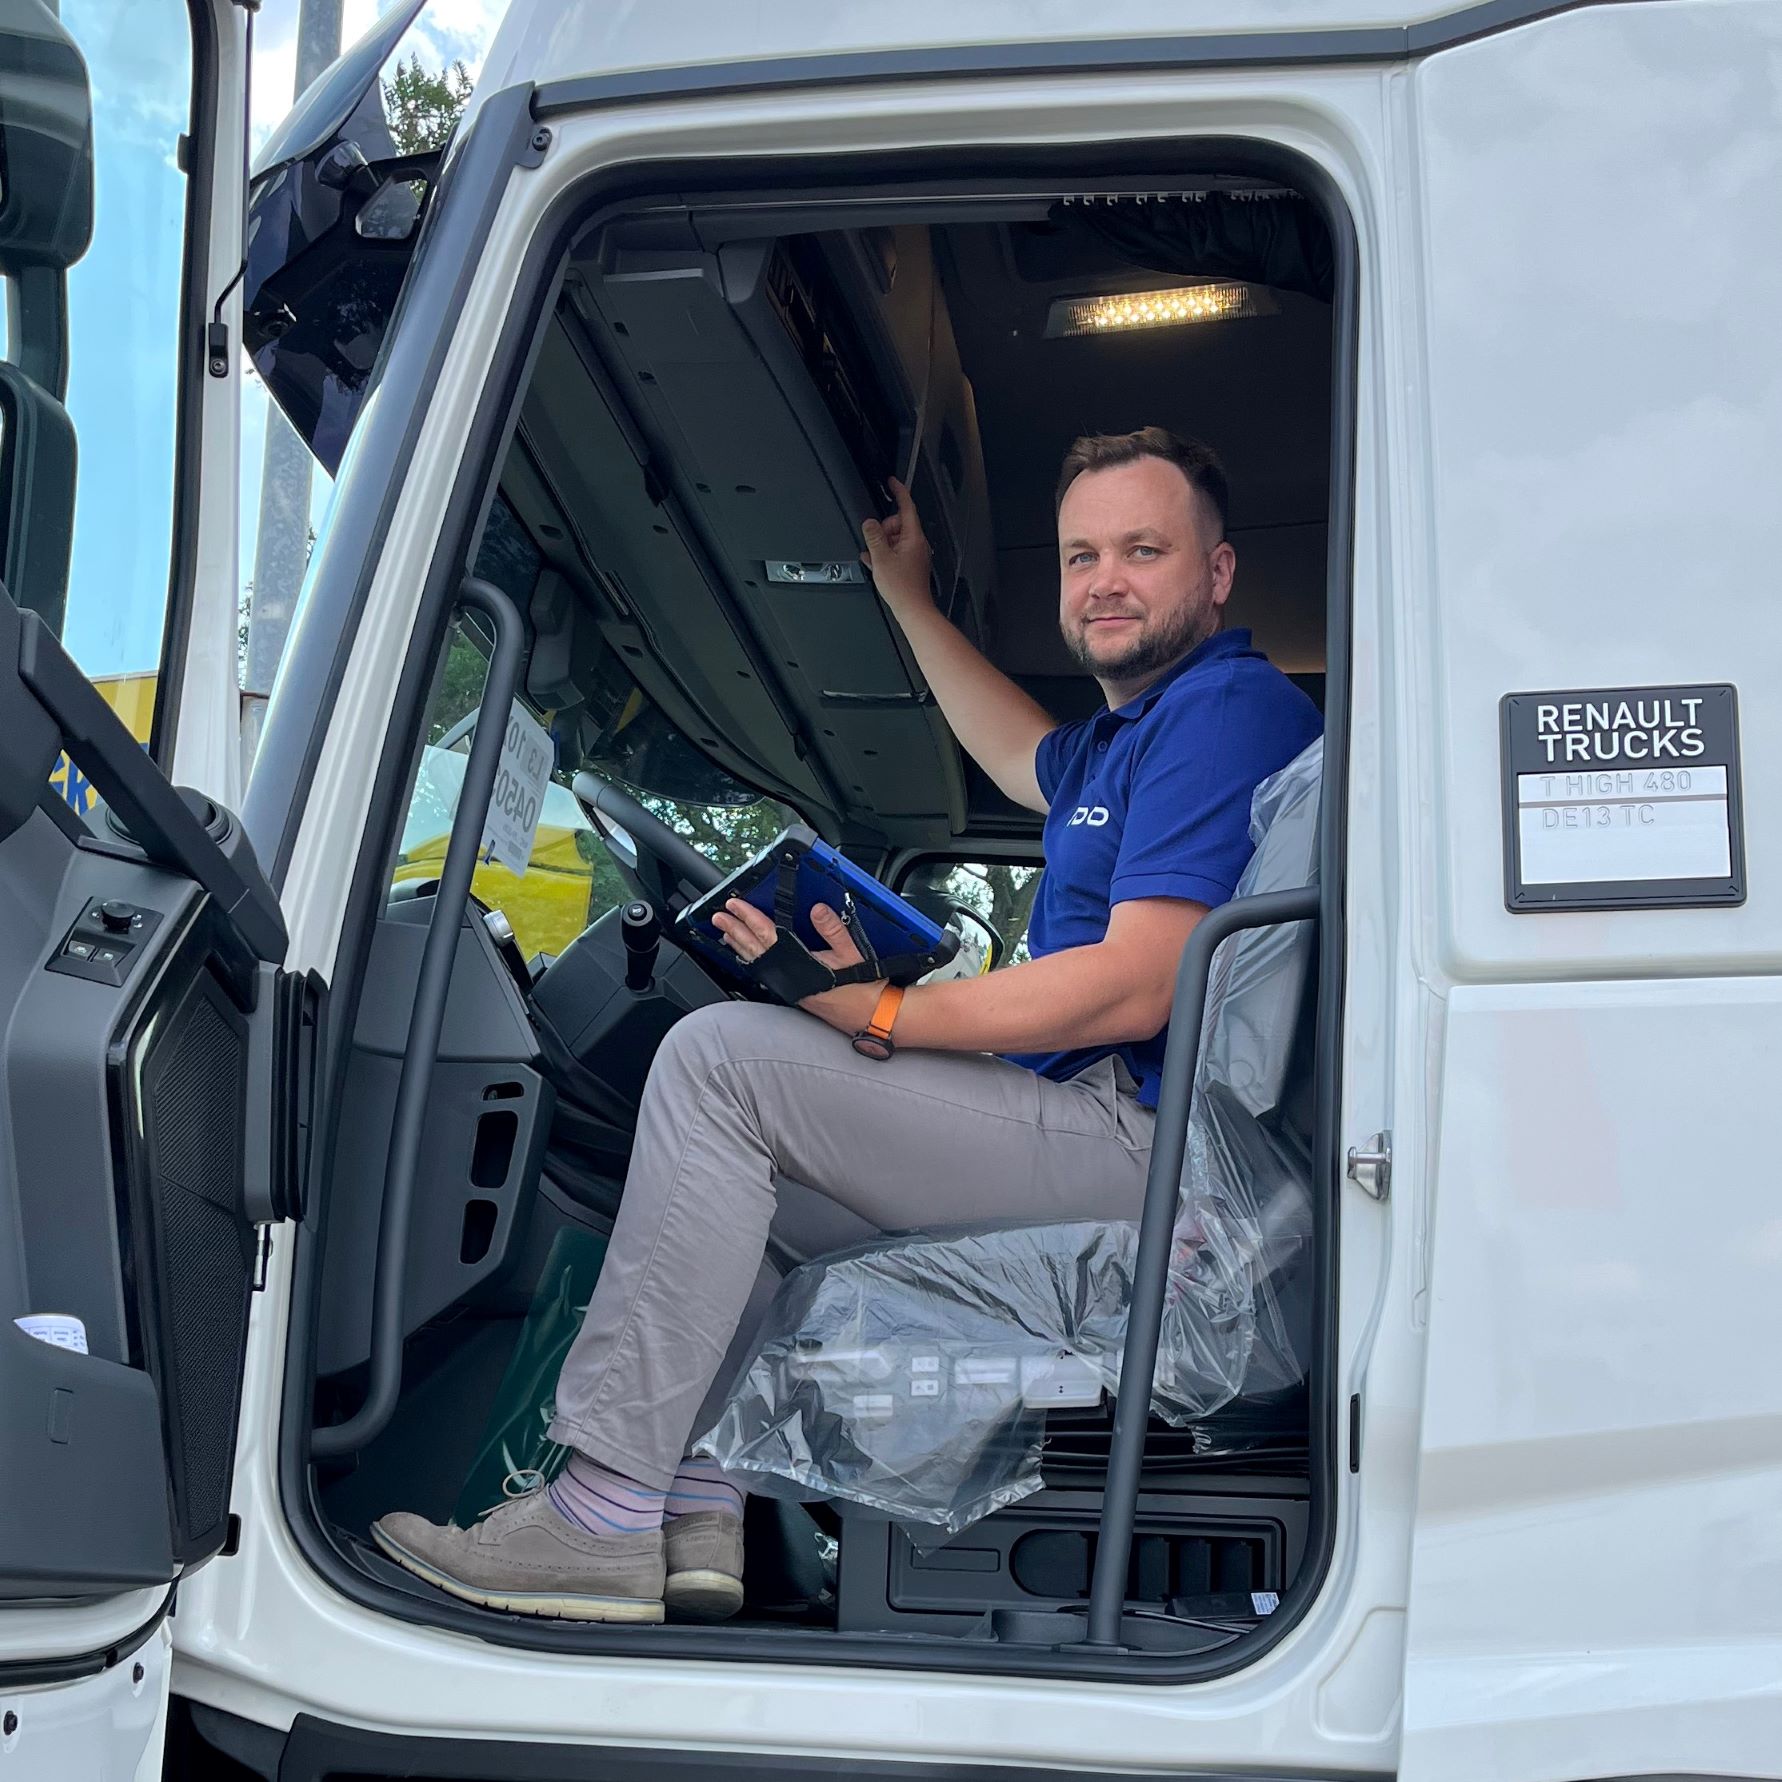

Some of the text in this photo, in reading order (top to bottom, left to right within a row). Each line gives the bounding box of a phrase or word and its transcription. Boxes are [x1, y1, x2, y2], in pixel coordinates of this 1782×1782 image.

[1537, 698, 1703, 733] RENAULT
[1538, 728, 1705, 763] TRUCKS
[1540, 770, 1692, 797] T HIGH 480
[1543, 804, 1656, 830] DE13 TC
